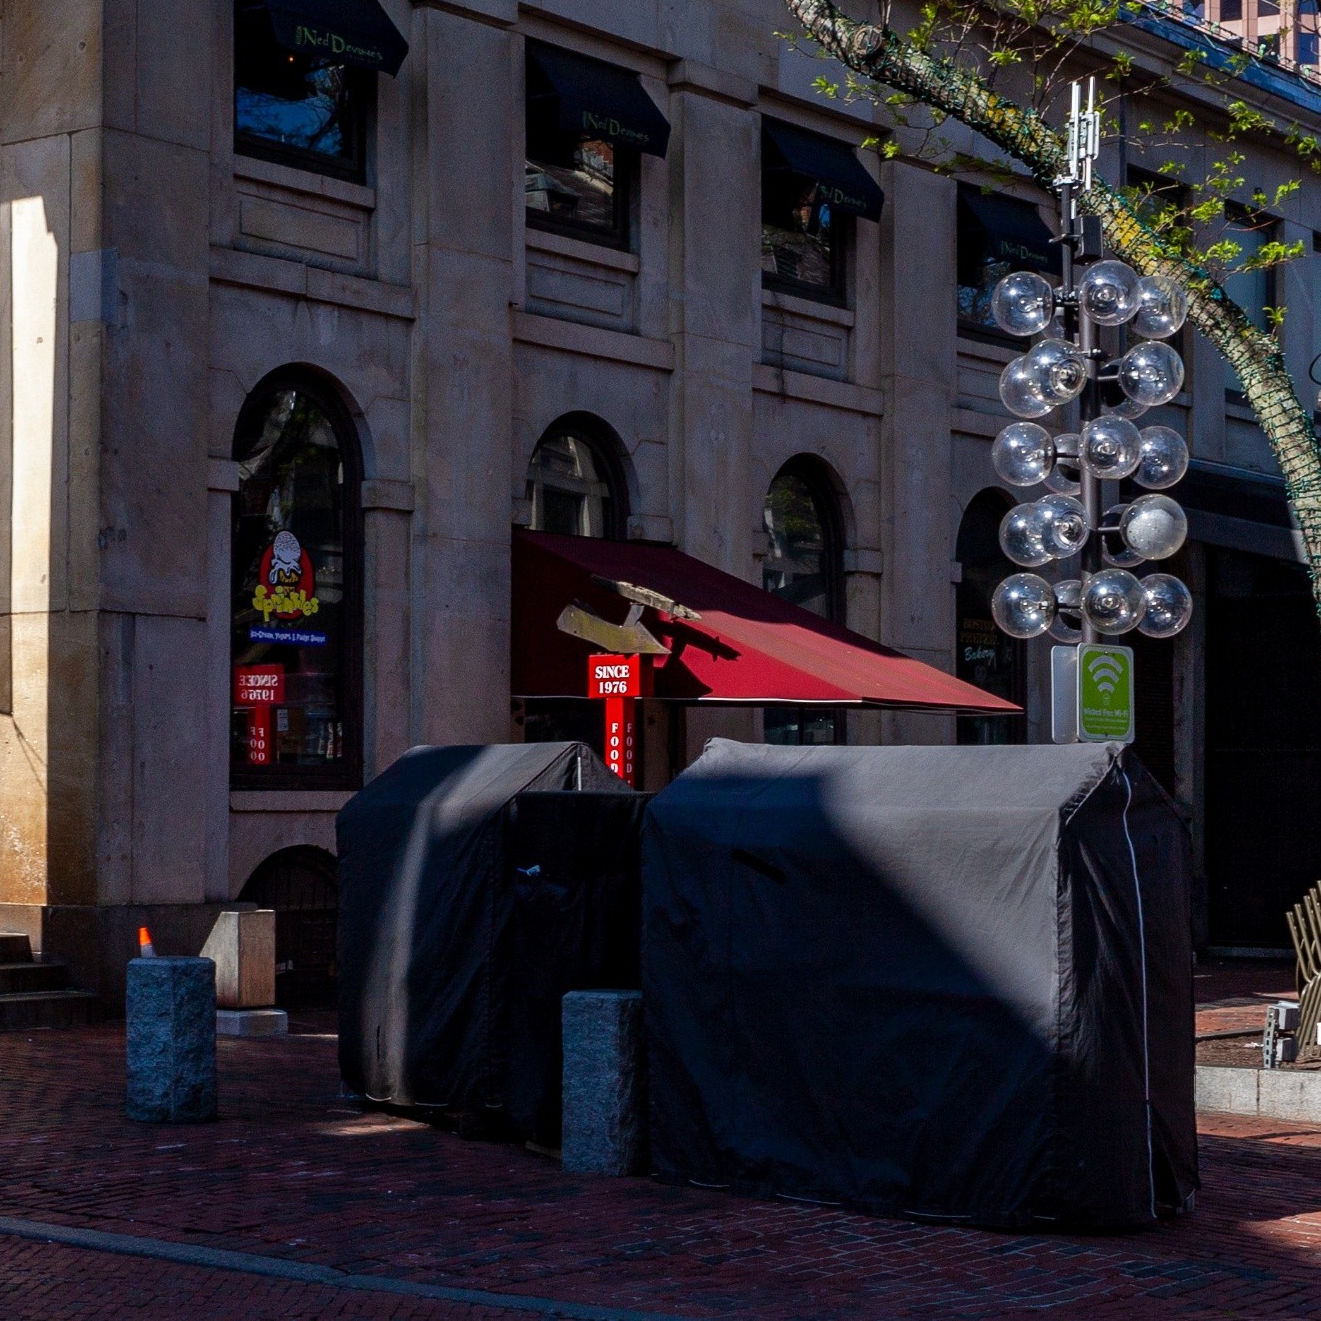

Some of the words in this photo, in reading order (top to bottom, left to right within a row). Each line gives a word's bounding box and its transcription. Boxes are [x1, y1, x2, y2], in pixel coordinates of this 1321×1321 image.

[252, 584, 319, 622] Sprinkles
[595, 665, 630, 679] SINCE
[599, 681, 628, 694] 1976
[610, 723, 619, 773] FOOD
